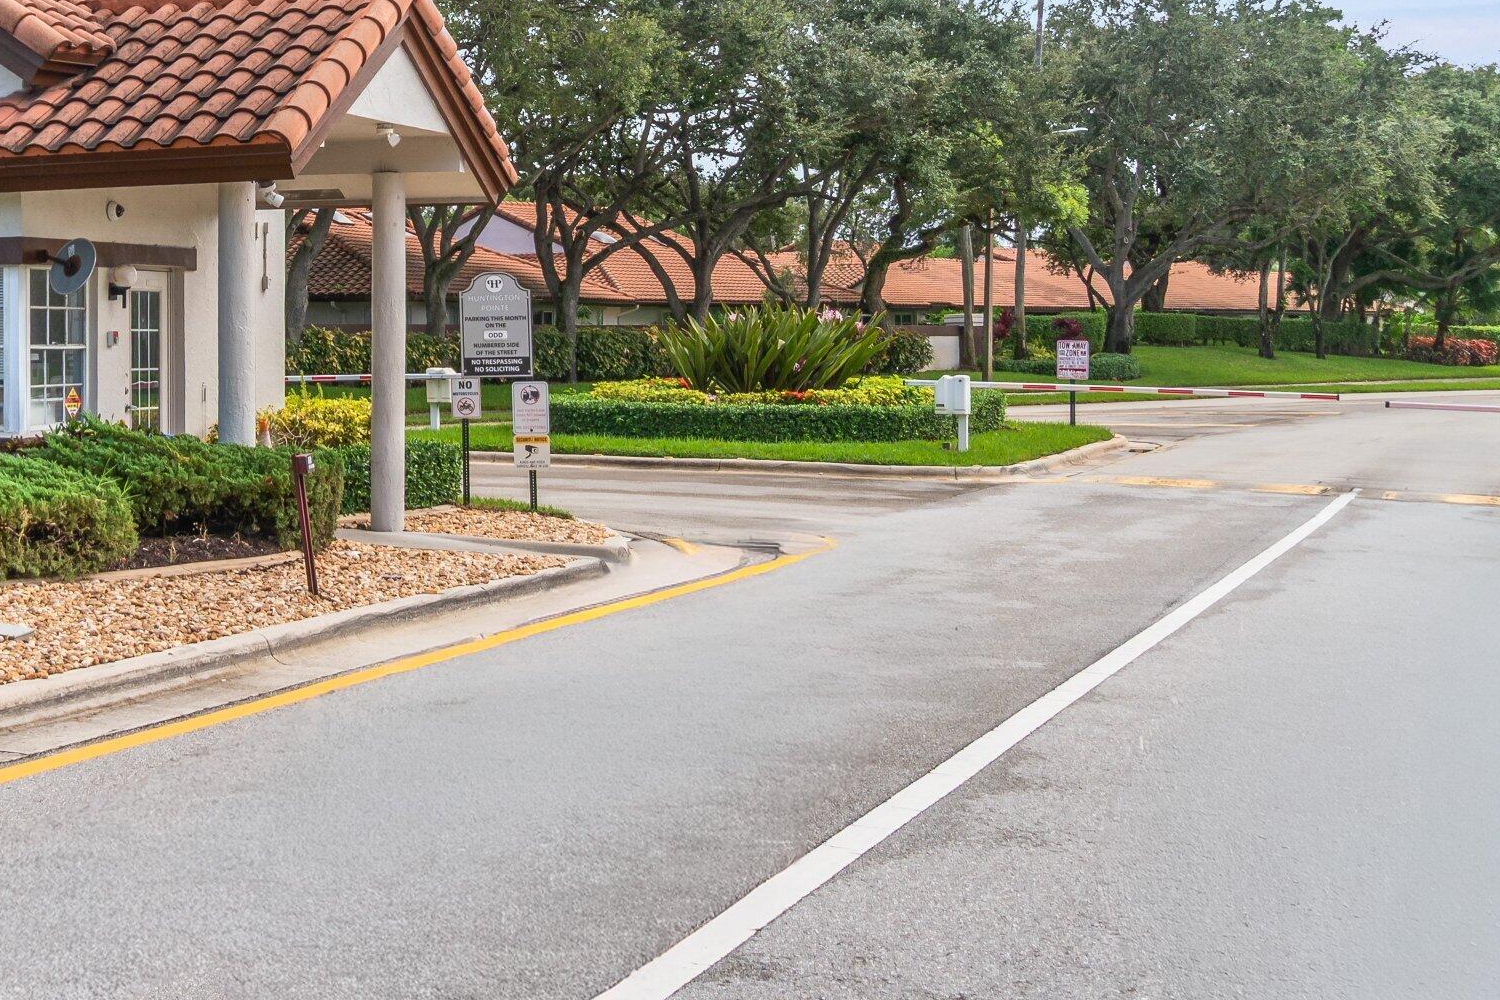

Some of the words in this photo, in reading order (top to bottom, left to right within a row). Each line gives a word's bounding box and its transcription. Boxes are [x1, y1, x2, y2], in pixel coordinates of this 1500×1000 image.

[468, 294, 520, 302] HUNTINGTON
[1066, 349, 1079, 357] ZONE
[458, 380, 473, 389] NO
